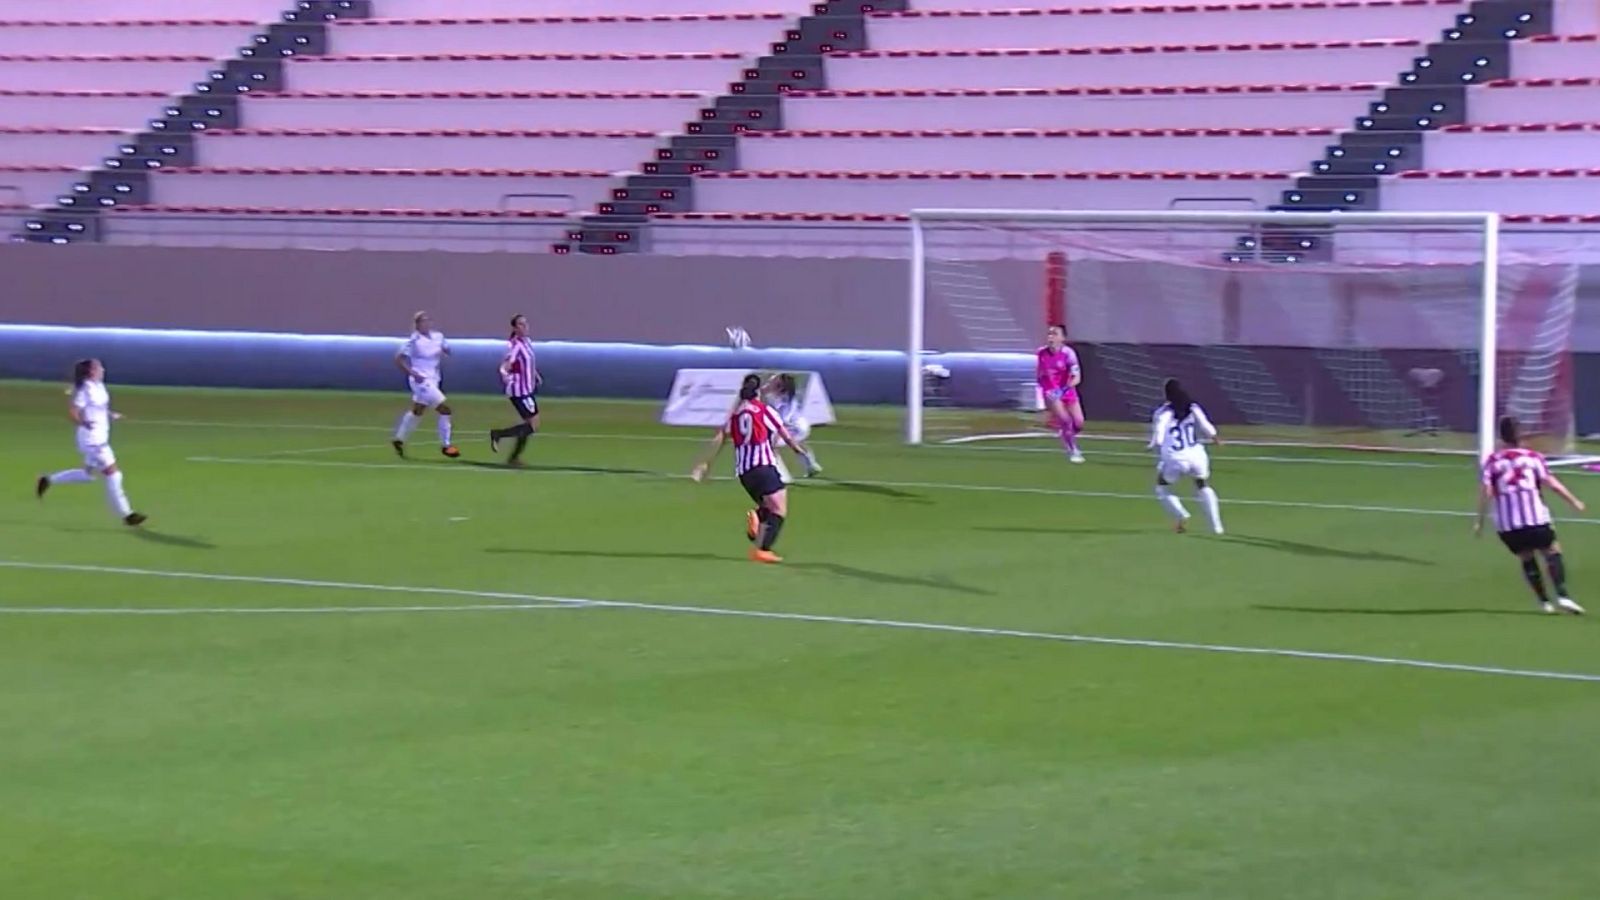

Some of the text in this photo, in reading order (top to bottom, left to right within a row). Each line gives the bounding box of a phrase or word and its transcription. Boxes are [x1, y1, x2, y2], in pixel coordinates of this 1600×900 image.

[738, 412, 753, 444] 9
[1169, 423, 1196, 451] 30
[1495, 456, 1534, 492] 23
